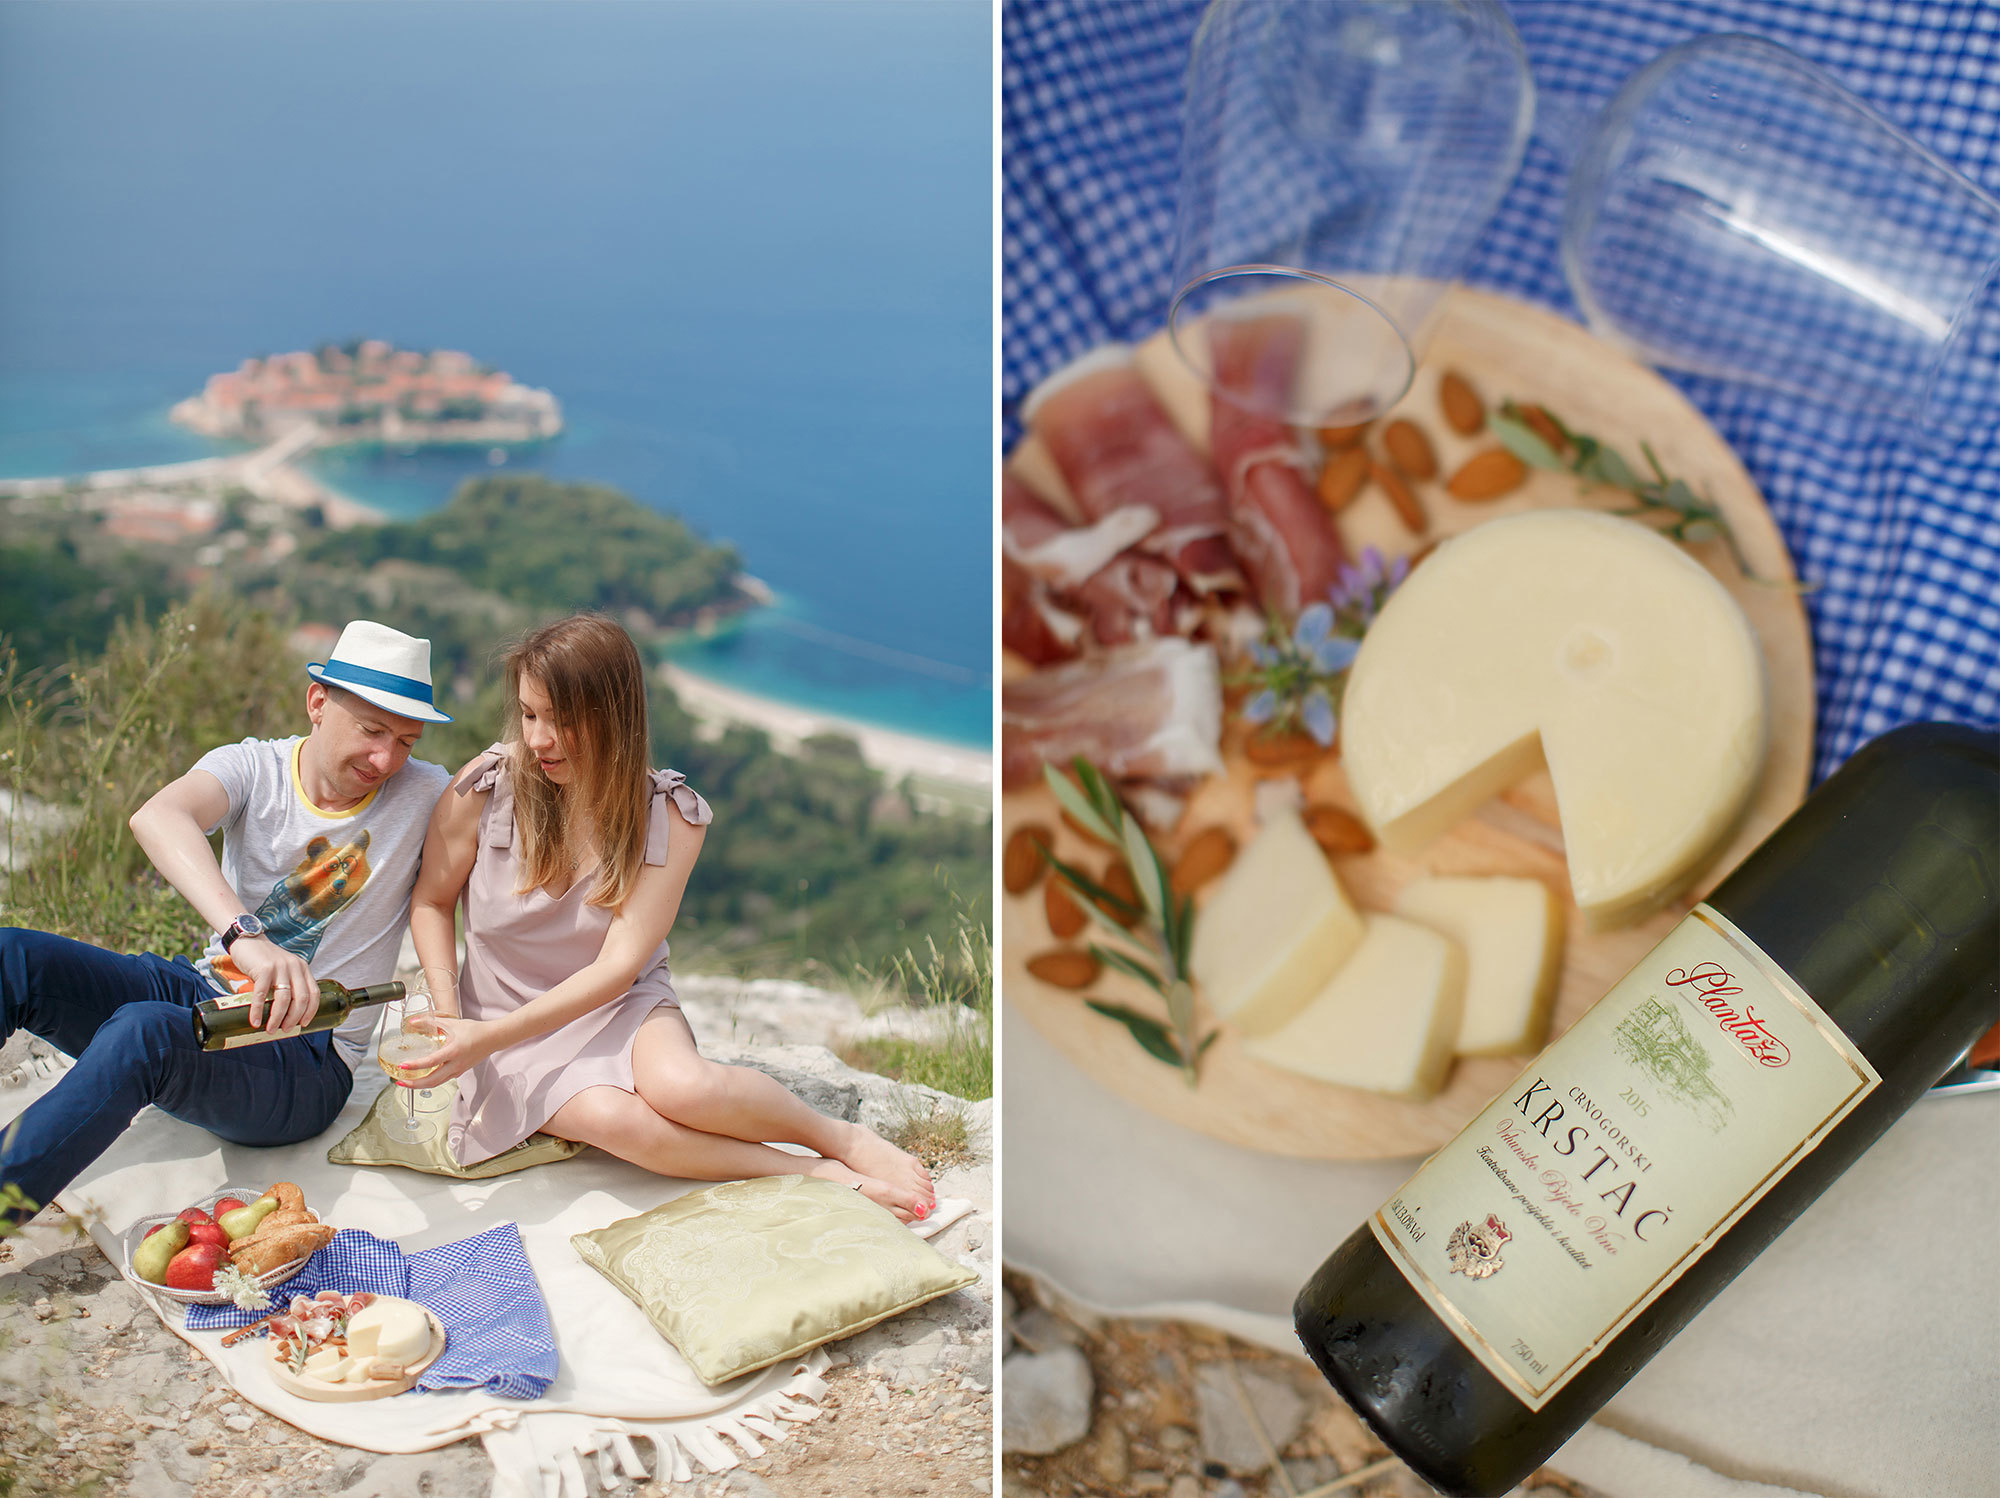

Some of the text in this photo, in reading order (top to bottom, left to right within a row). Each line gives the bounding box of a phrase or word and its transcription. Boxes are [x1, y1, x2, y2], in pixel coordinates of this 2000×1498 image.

[1665, 961, 1791, 1068] Plantaže
[1568, 1086, 1652, 1173] CRNOGORSKI
[1618, 1085, 1652, 1118] 2015
[1496, 1118, 1627, 1256] Vrhunsko Bijelo Vino
[1513, 1077, 1674, 1242] KRSTAČ
[1556, 1236, 1593, 1270] kvalitet
[1511, 1337, 1549, 1375] 750 ml
